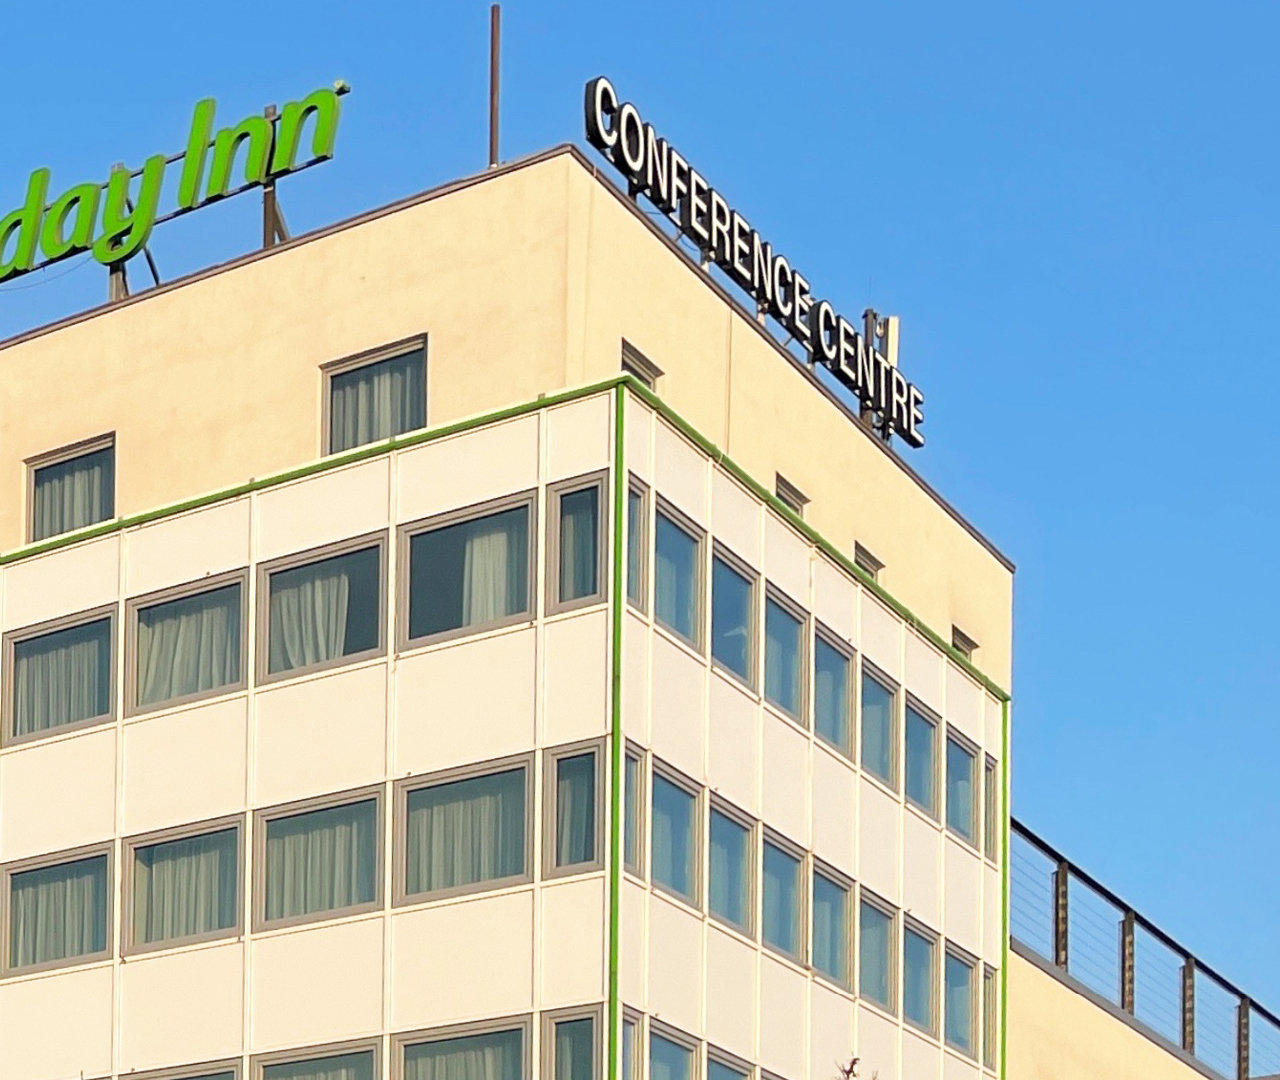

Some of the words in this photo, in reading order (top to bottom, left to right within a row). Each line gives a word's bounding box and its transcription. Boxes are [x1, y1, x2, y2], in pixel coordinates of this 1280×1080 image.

[178, 88, 342, 209] Inn
[585, 76, 811, 320] CONFERENCE
[814, 300, 925, 446] CENTRE
